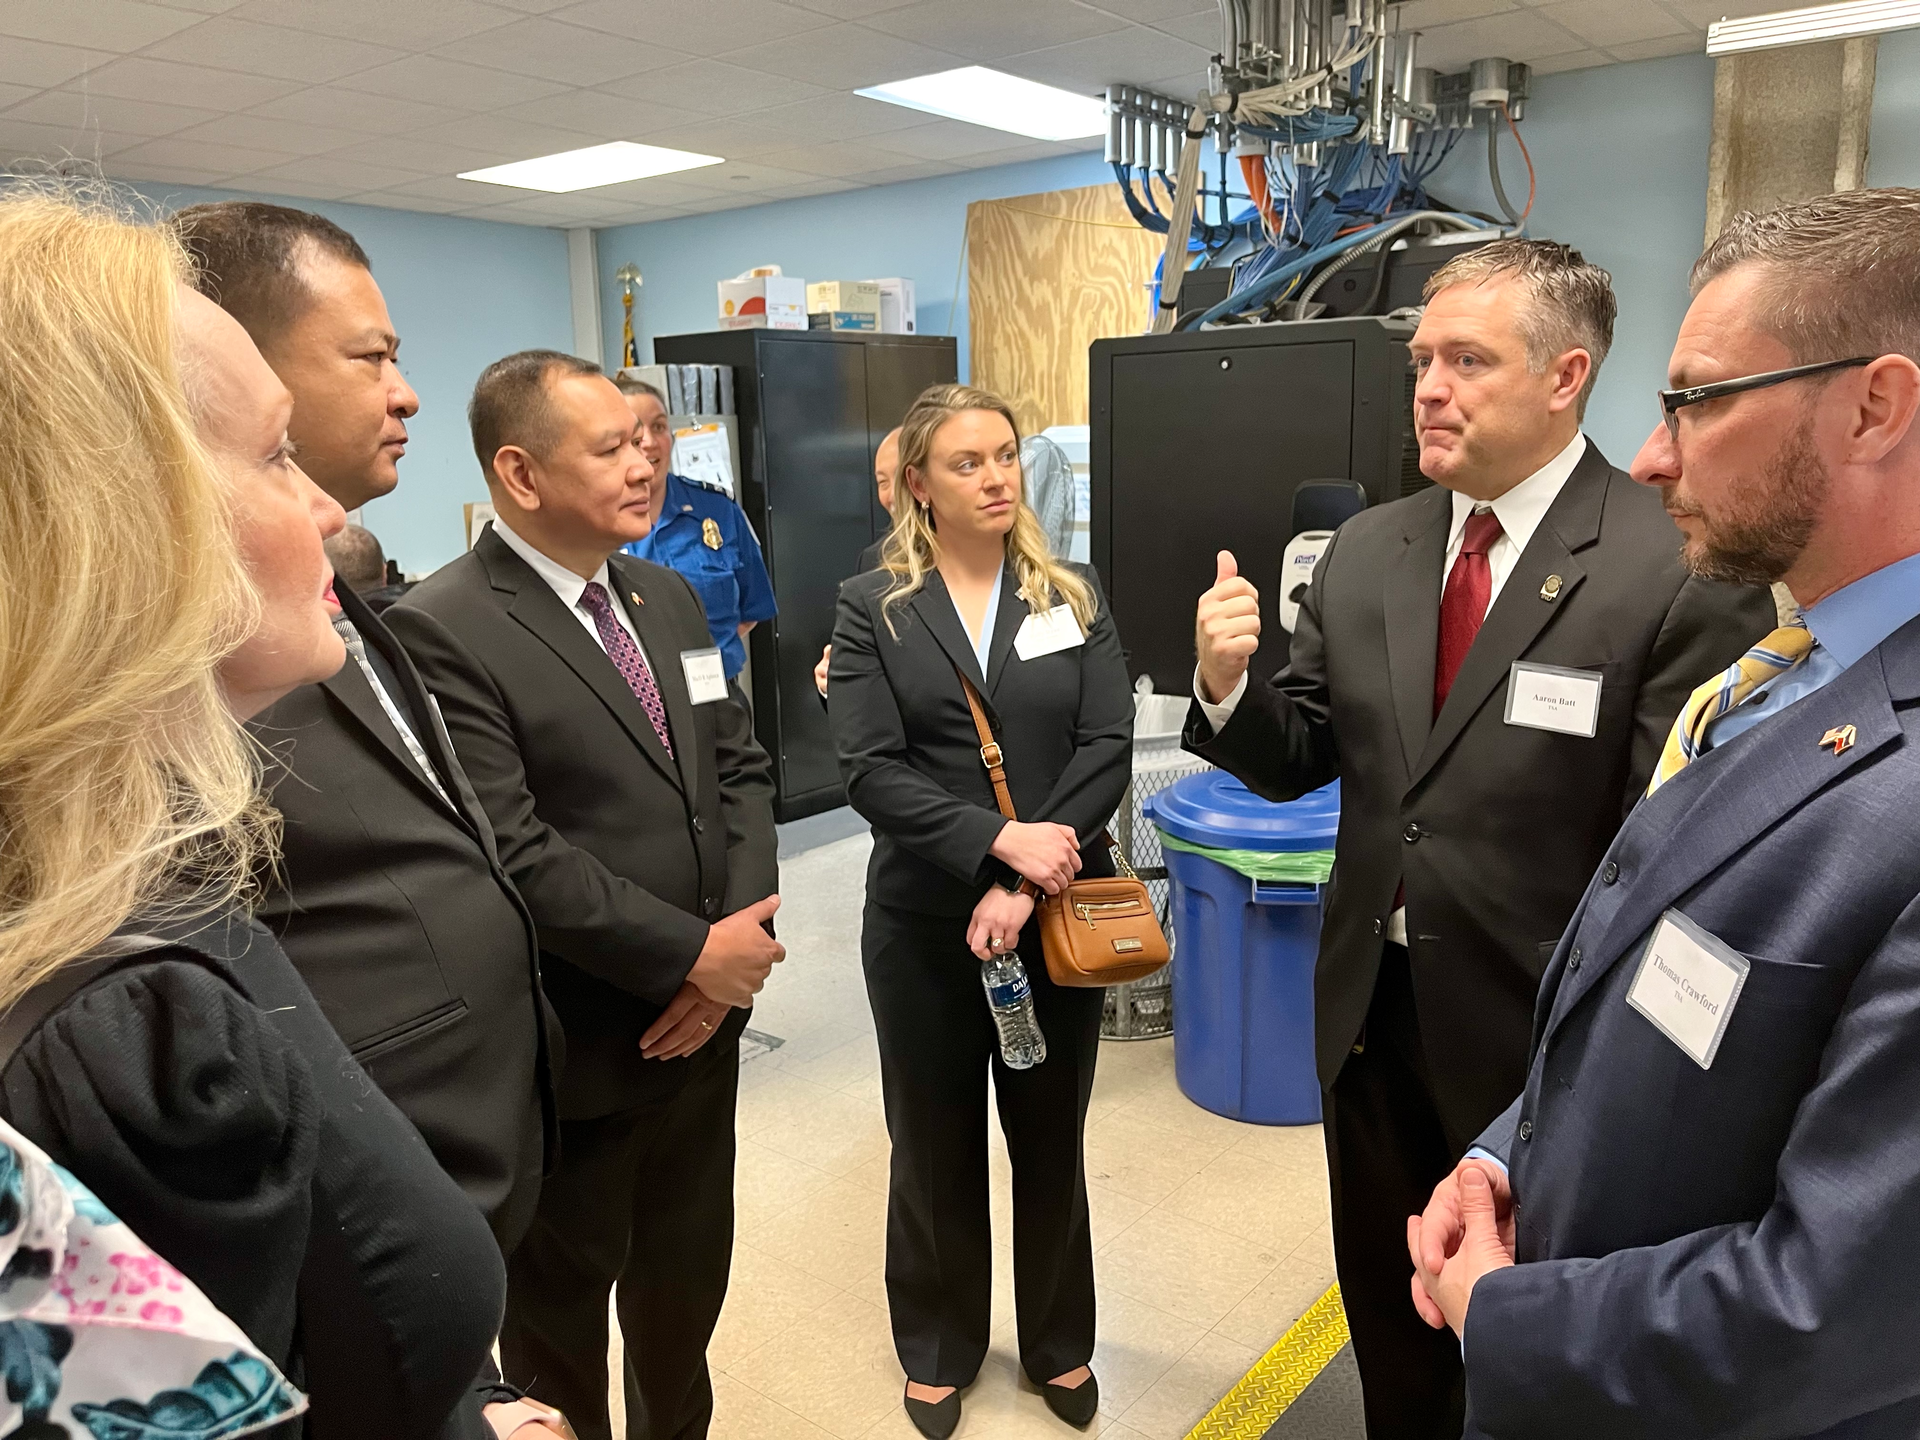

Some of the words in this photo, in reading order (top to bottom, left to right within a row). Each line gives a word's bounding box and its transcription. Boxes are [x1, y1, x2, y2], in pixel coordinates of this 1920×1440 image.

[1532, 693, 1557, 704] Aaron
[1559, 697, 1576, 707] Batt
[1653, 954, 1681, 985] Thomas
[1681, 978, 1719, 1016] Crawford
